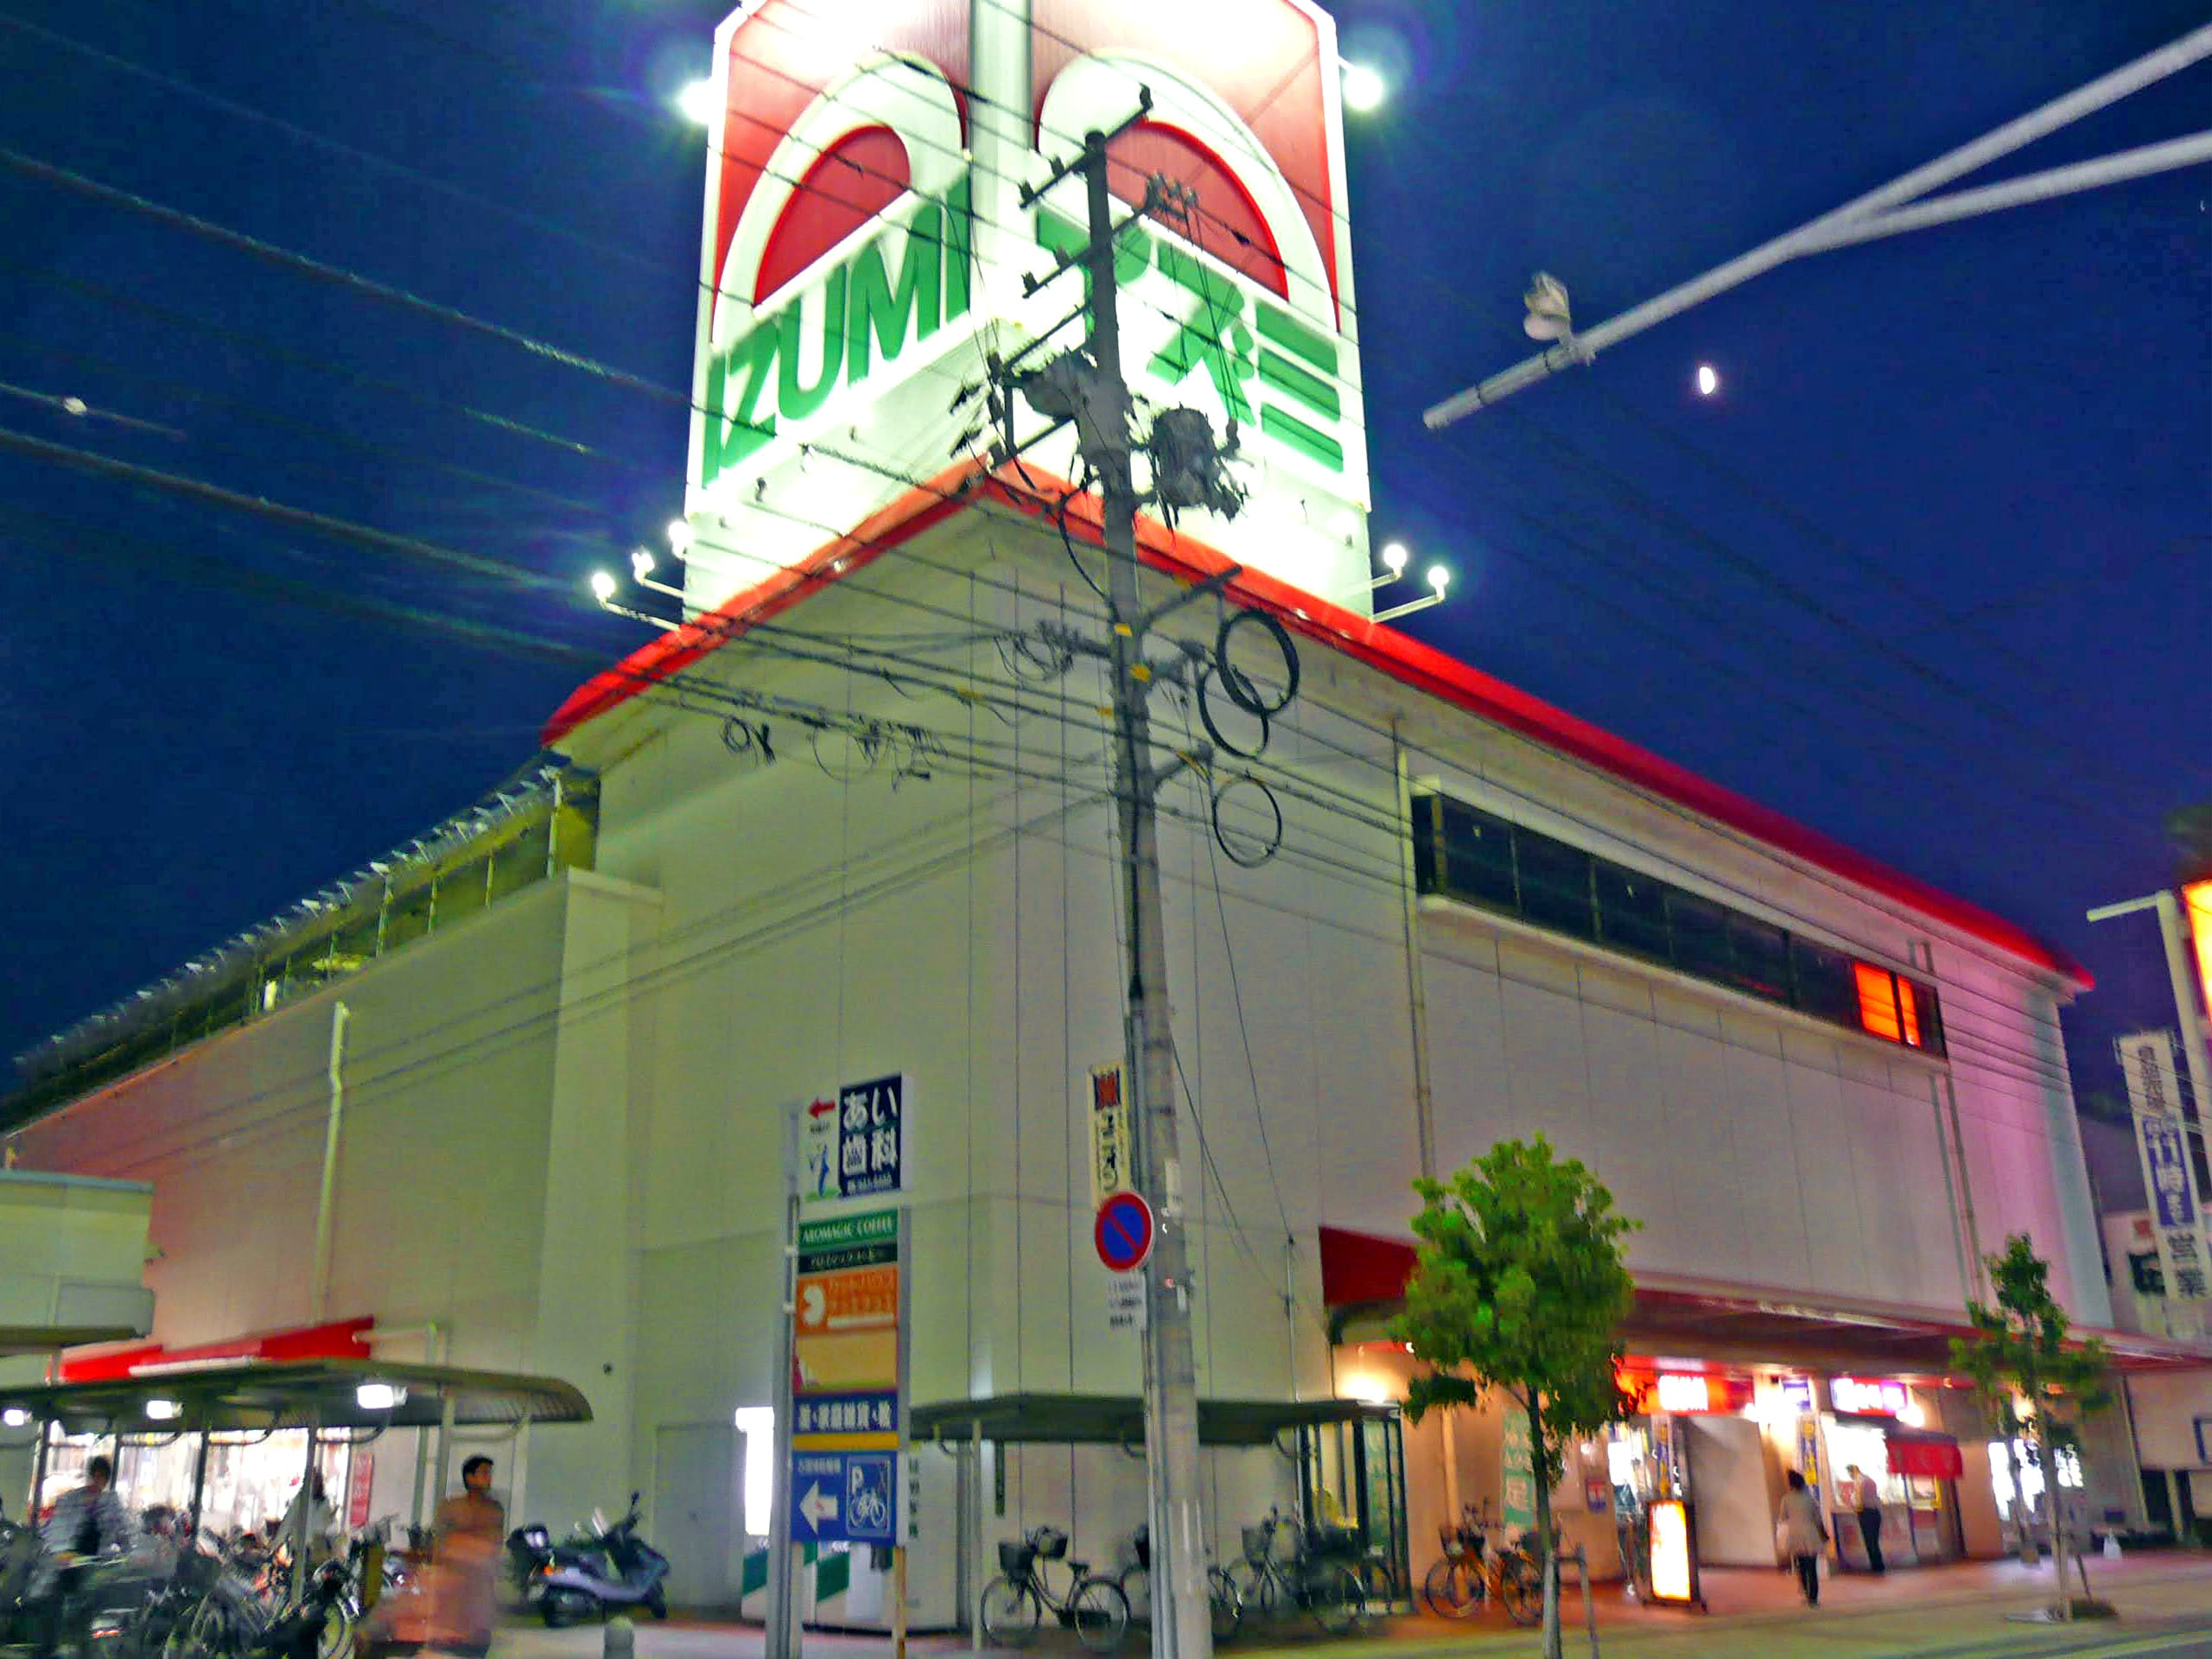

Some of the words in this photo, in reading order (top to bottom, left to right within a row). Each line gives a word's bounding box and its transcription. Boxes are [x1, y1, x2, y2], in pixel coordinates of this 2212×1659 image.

[702, 175, 970, 489] IZUMI
[843, 1085, 898, 1131] あい
[842, 1126, 898, 1176] 歯科
[856, 1215, 893, 1236] COFFEE
